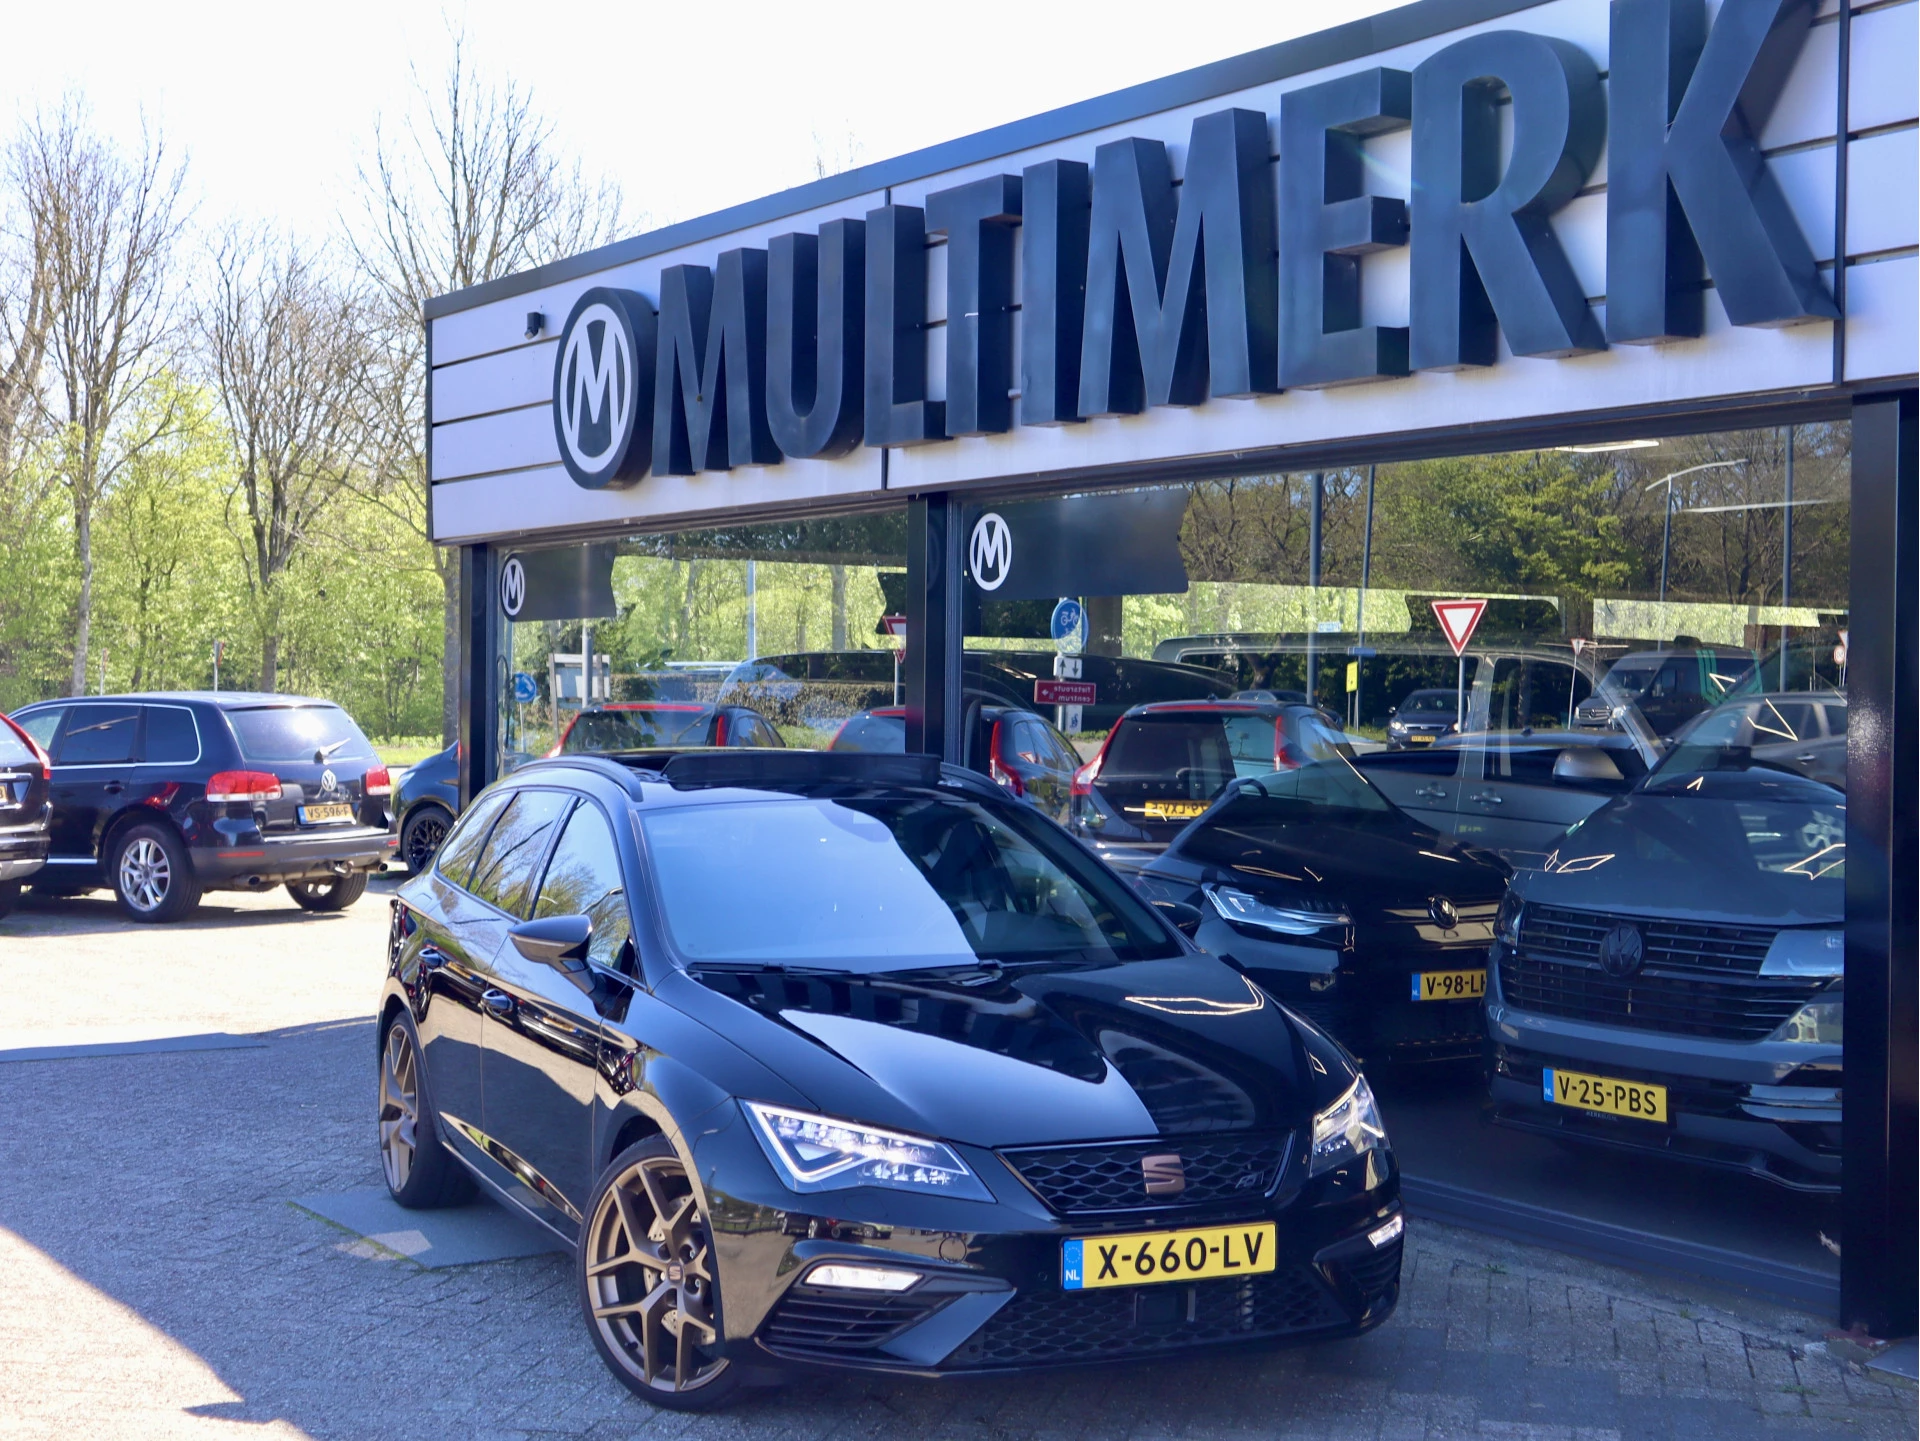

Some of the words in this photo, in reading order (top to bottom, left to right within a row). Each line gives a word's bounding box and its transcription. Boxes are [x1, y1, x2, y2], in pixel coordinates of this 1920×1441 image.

[651, 0, 1838, 477] MULTIMERK
[308, 806, 349, 818] VS-596-F
[1558, 1075, 1657, 1116] V-25-PBS
[1065, 1269, 1081, 1281] NL
[1097, 1231, 1264, 1280] X-660-LV
